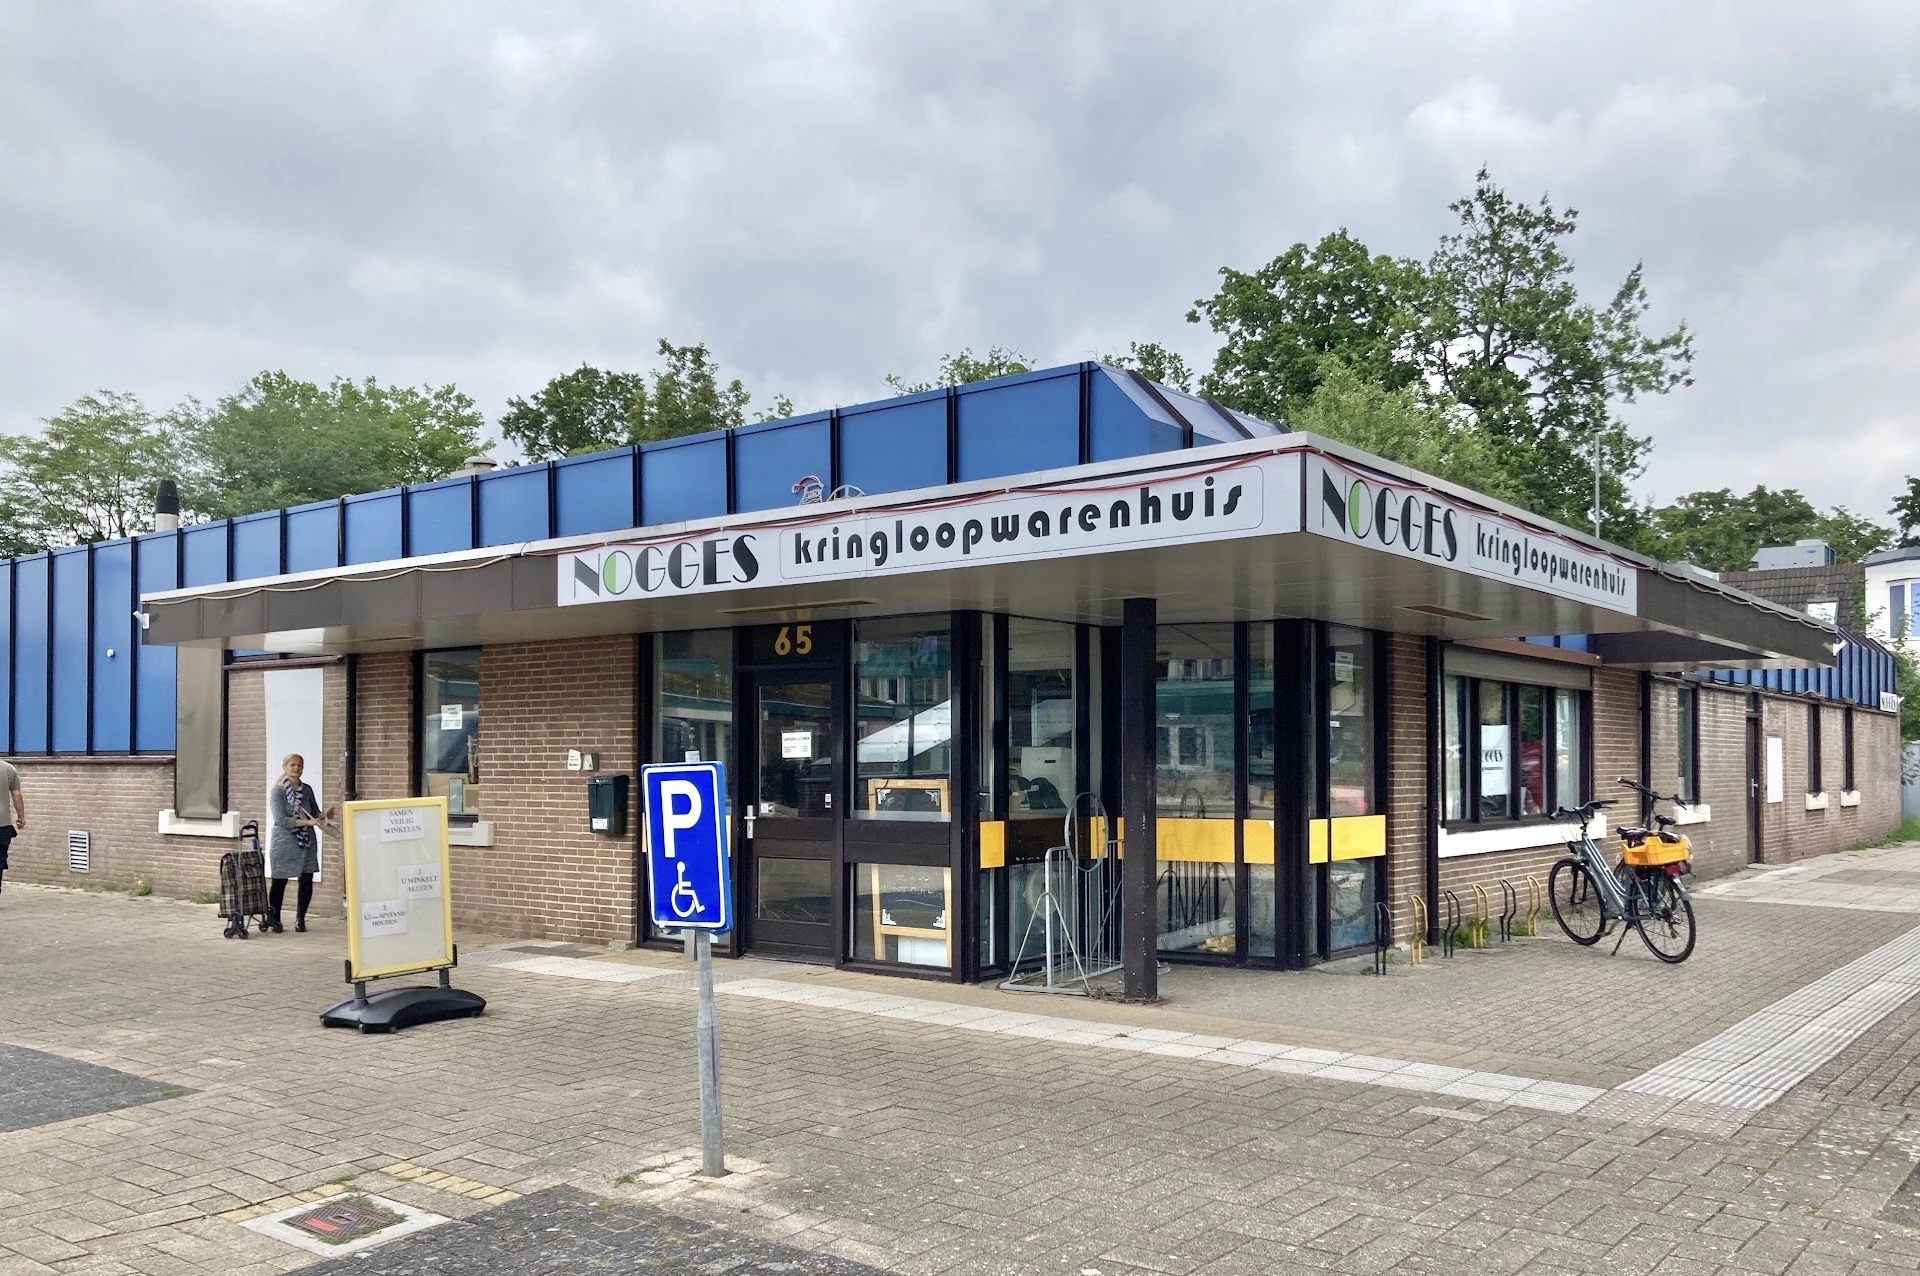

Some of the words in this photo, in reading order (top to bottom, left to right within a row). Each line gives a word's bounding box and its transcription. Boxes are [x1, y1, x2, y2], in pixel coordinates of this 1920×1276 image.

[574, 533, 759, 598] NOGGES
[795, 476, 1243, 567] kringloopwarenhuis
[1322, 467, 1458, 562] NOGGES
[1477, 522, 1626, 597] kringloopwarenhuis
[774, 625, 812, 656] 65
[389, 809, 413, 817] SAMEN
[390, 817, 414, 825] VEILIG
[660, 779, 702, 858] P
[383, 825, 421, 834] WINKELEN
